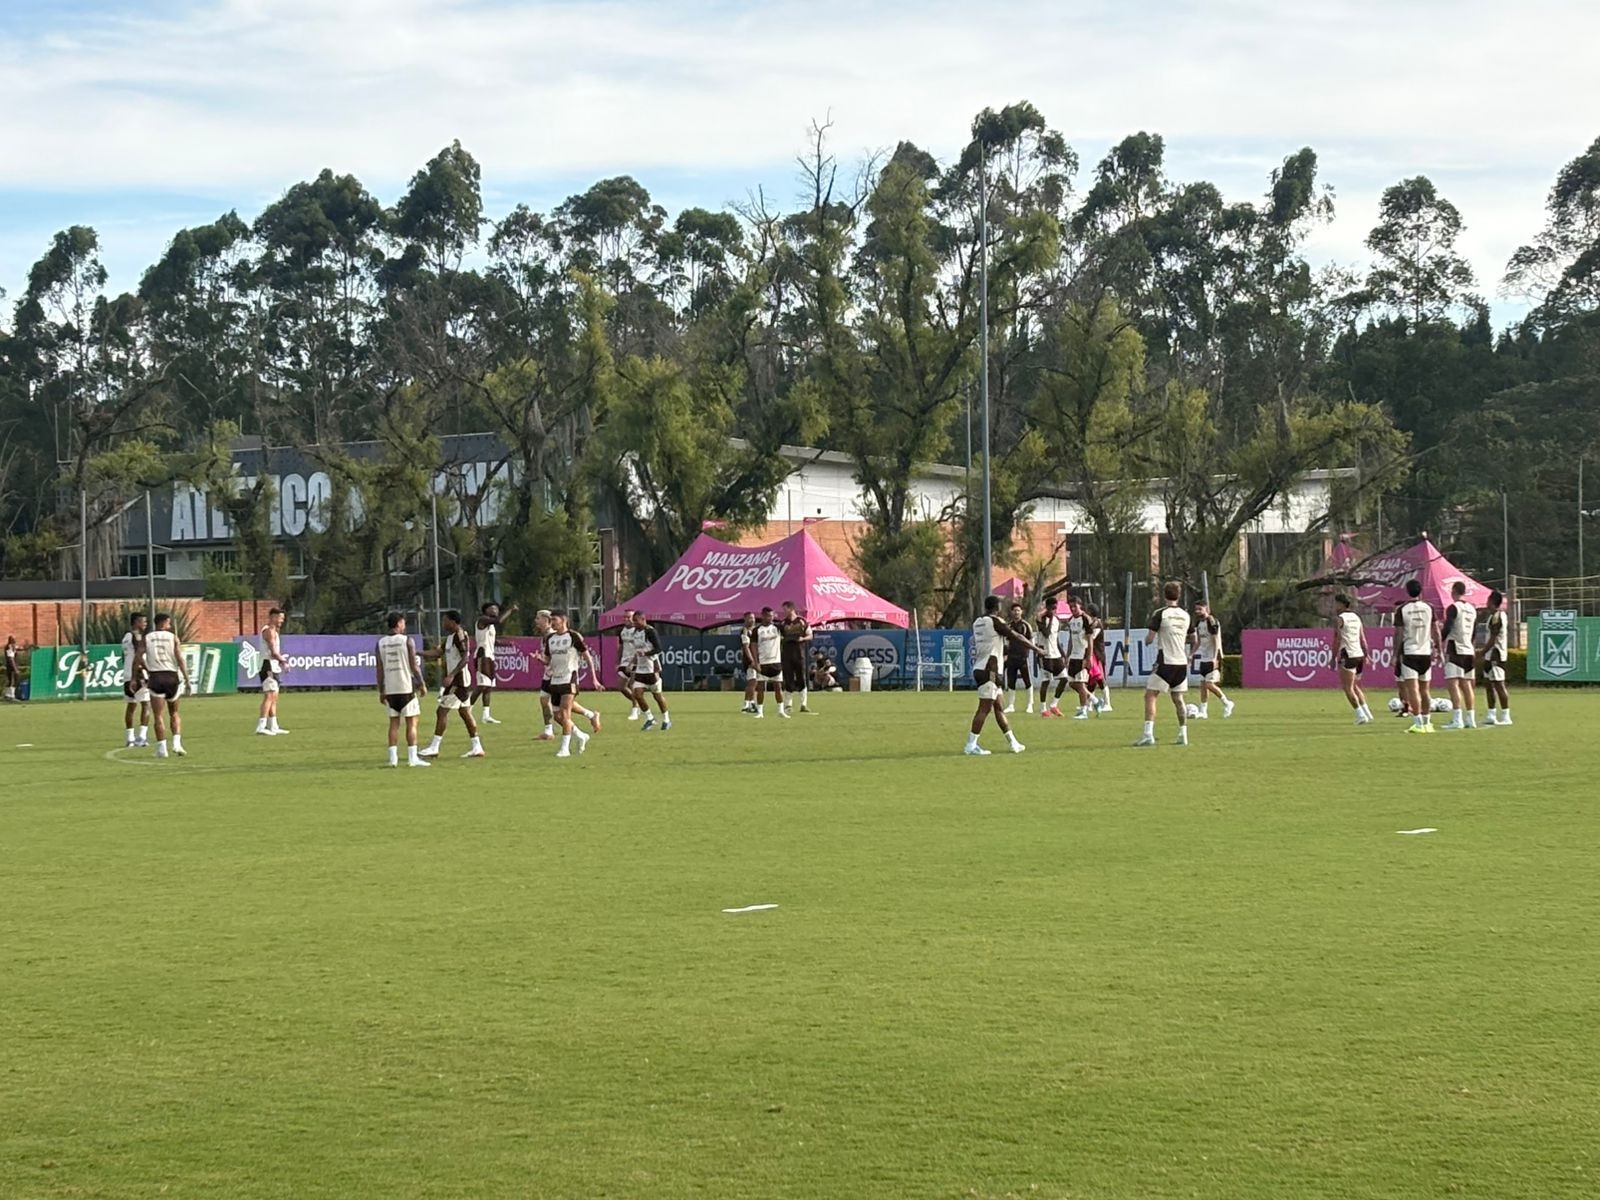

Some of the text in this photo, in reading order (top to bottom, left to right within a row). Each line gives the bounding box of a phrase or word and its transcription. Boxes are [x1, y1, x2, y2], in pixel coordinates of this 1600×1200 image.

[171, 462, 332, 541] ATLICO
[702, 550, 772, 567] MANZANA
[1277, 638, 1320, 648] MANZANA
[283, 653, 356, 670] Cooperativa
[660, 645, 710, 665] nóstico
[56, 650, 124, 688] Pilse
